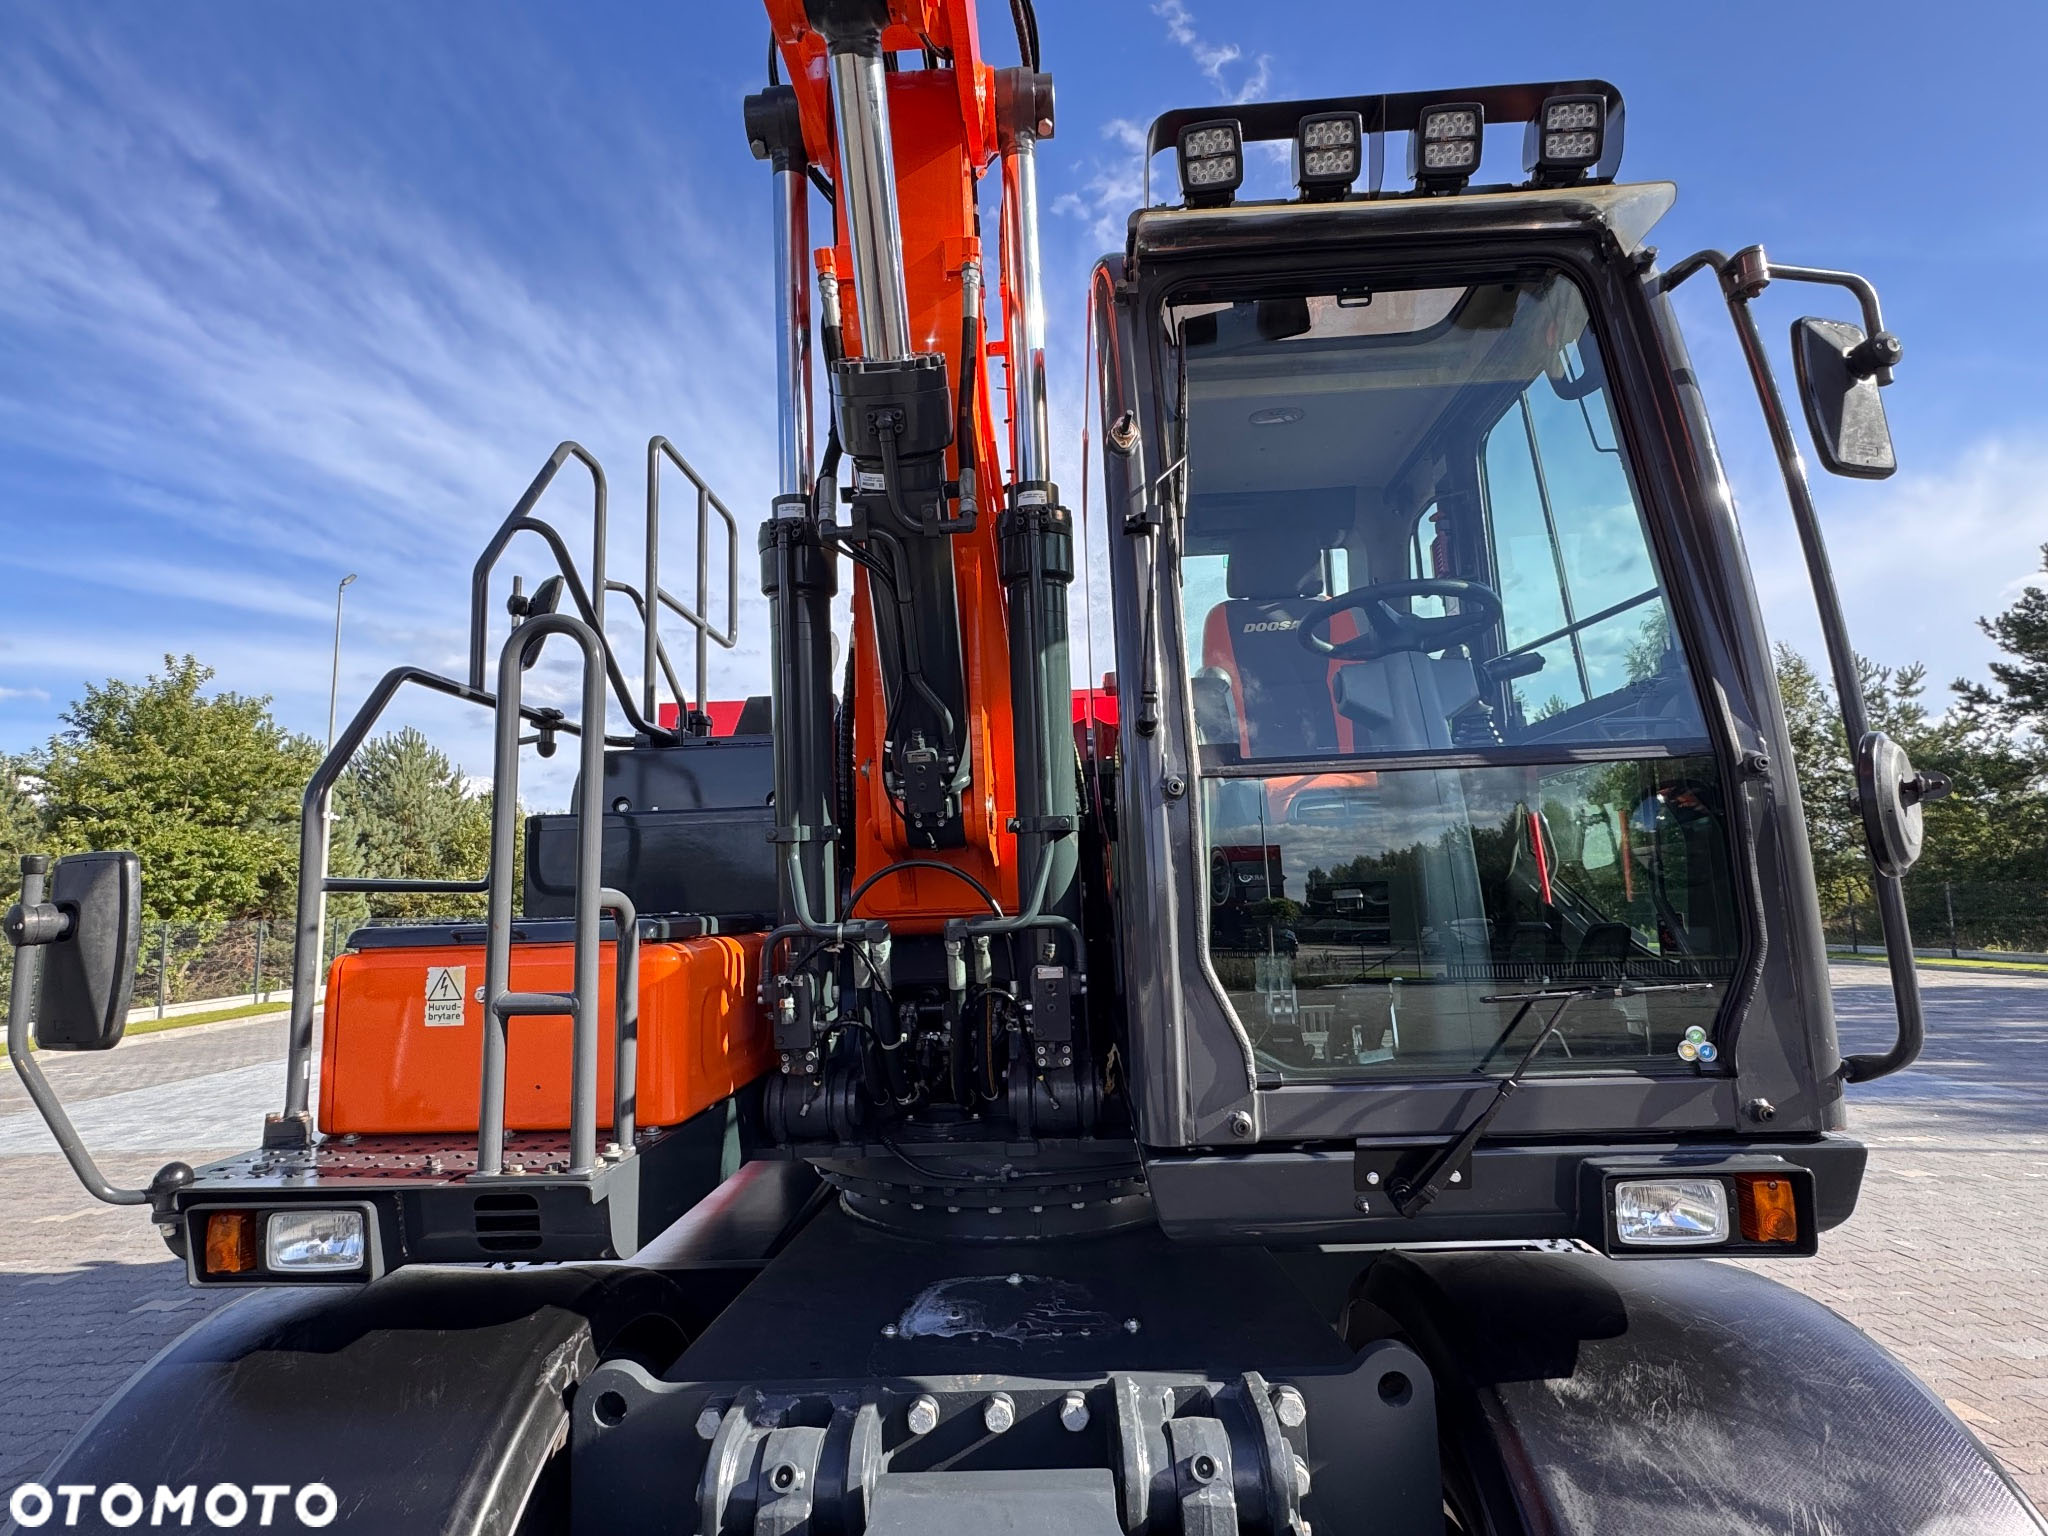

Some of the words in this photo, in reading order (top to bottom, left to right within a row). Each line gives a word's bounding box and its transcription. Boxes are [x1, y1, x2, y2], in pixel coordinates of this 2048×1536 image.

[1243, 620, 1302, 633] DOOSA
[428, 1002, 461, 1011] Huvud-
[428, 1012, 460, 1022] brytare
